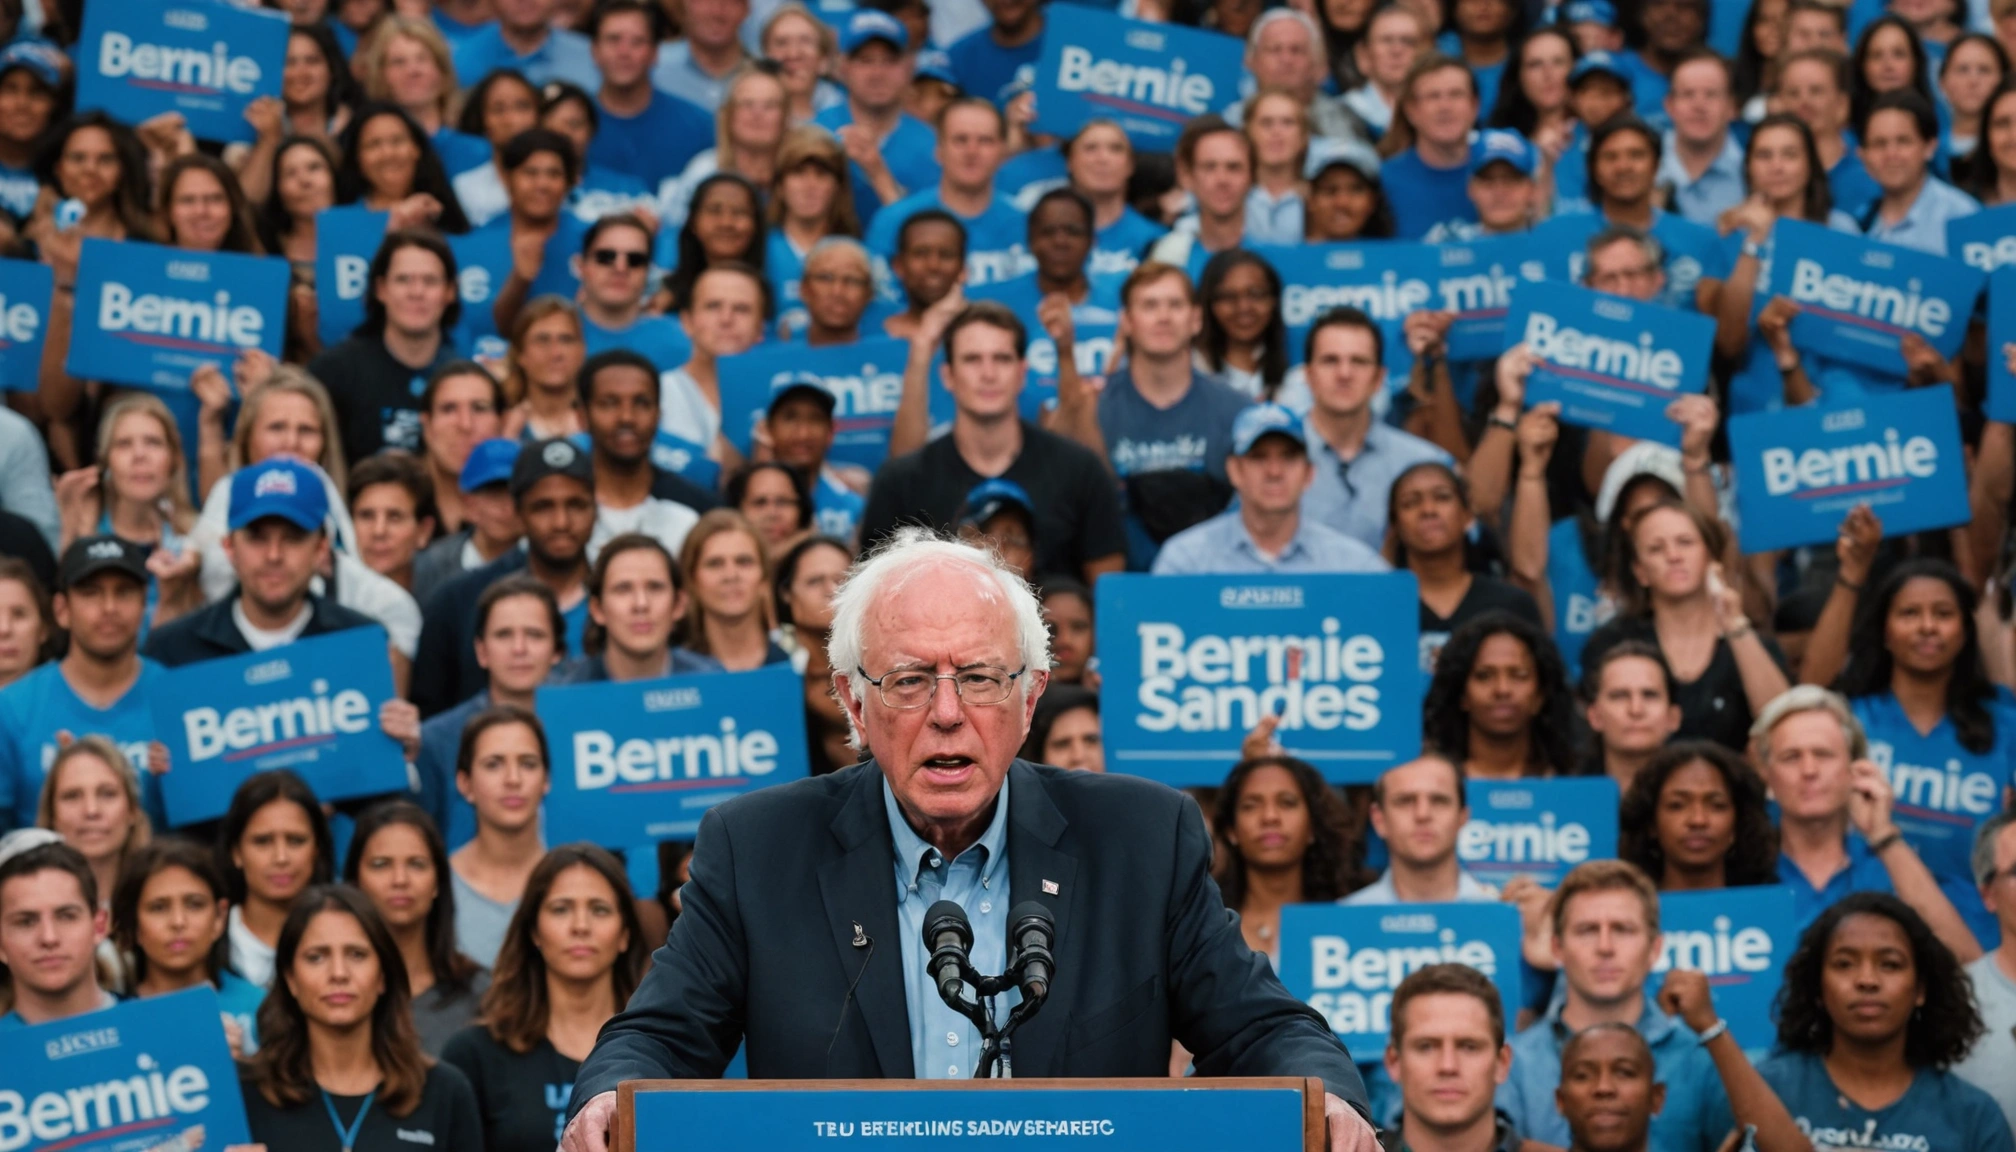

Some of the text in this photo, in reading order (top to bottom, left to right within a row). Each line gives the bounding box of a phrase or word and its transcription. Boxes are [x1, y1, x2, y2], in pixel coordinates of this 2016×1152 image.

[1762, 427, 1939, 496] Bernie
[183, 678, 371, 763] Bernie
[573, 716, 779, 790] Bernie
[1457, 811, 1591, 863] ernie
